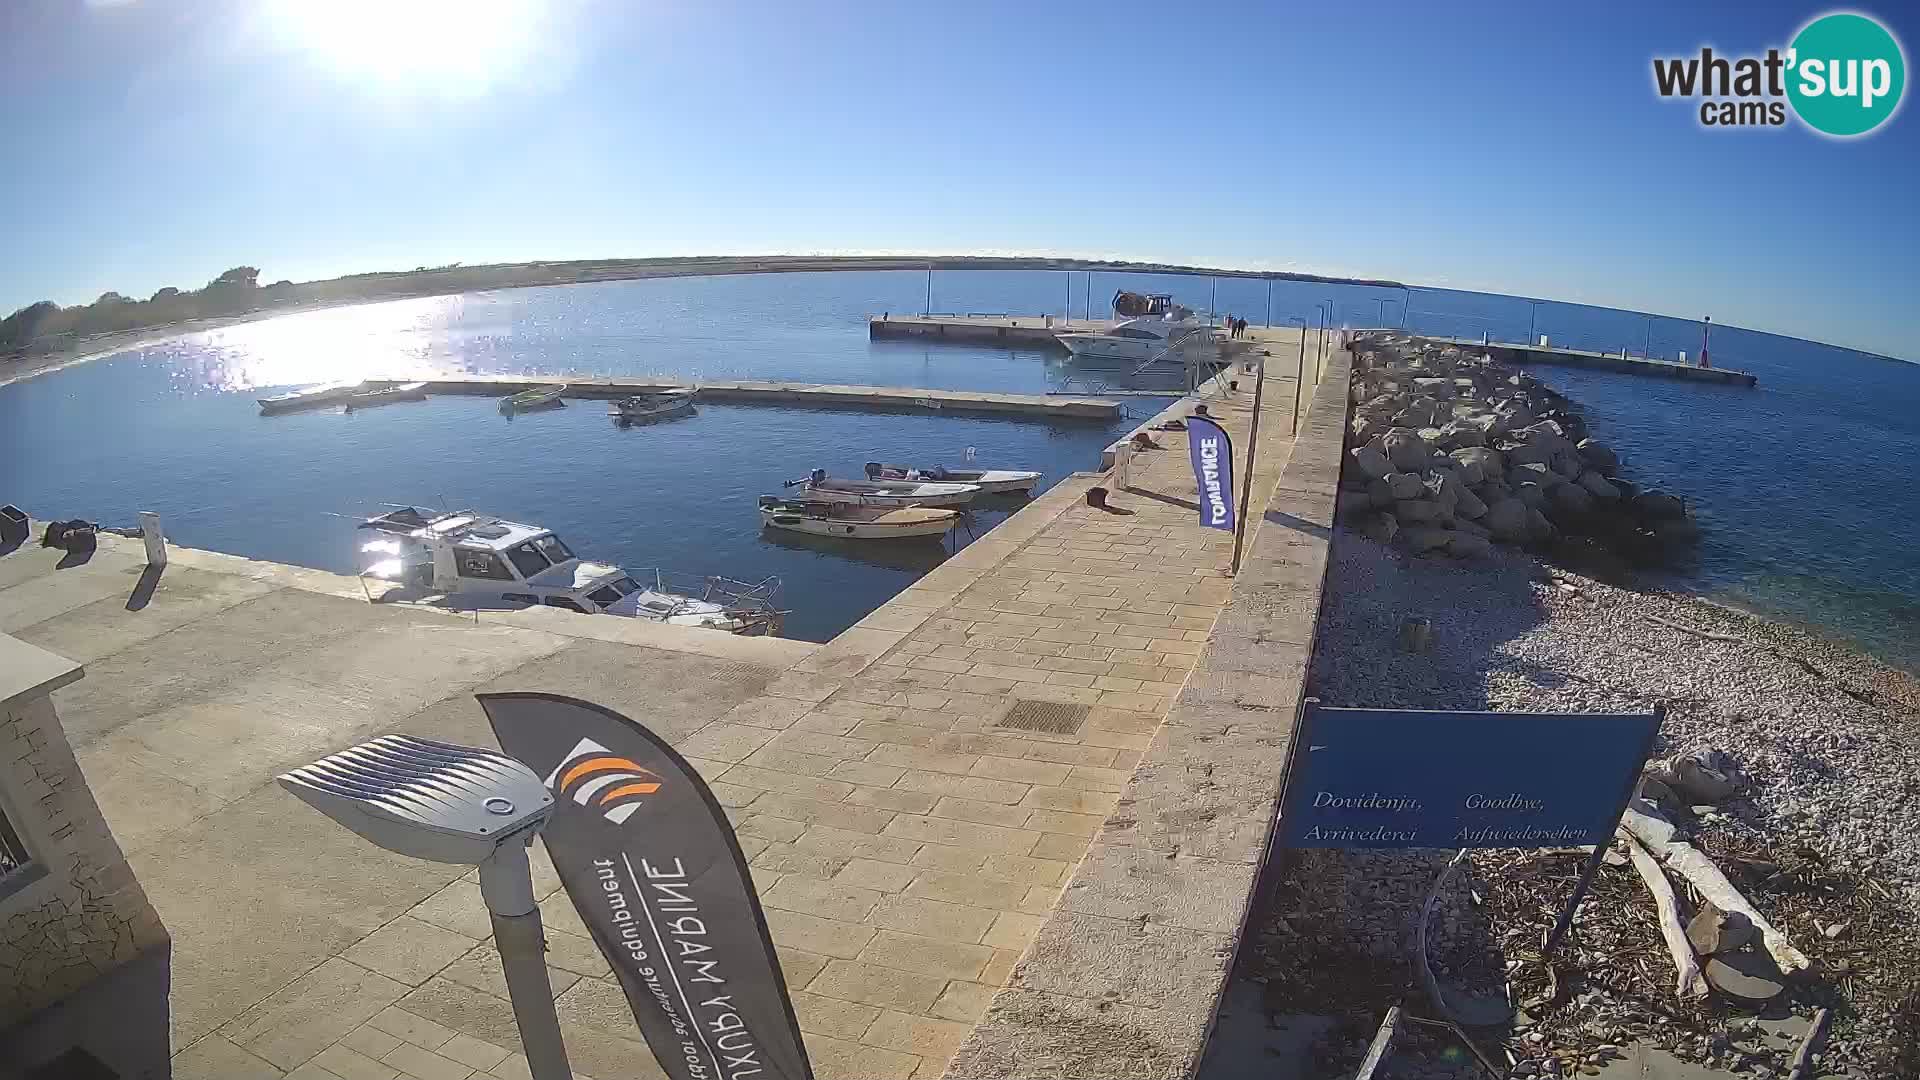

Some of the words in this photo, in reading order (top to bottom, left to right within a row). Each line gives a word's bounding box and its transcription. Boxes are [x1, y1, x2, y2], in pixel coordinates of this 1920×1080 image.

[1312, 791, 1424, 813] Dovidenja,
[1465, 793, 1544, 813] Goodbye,
[1303, 825, 1418, 841] Arrivederci
